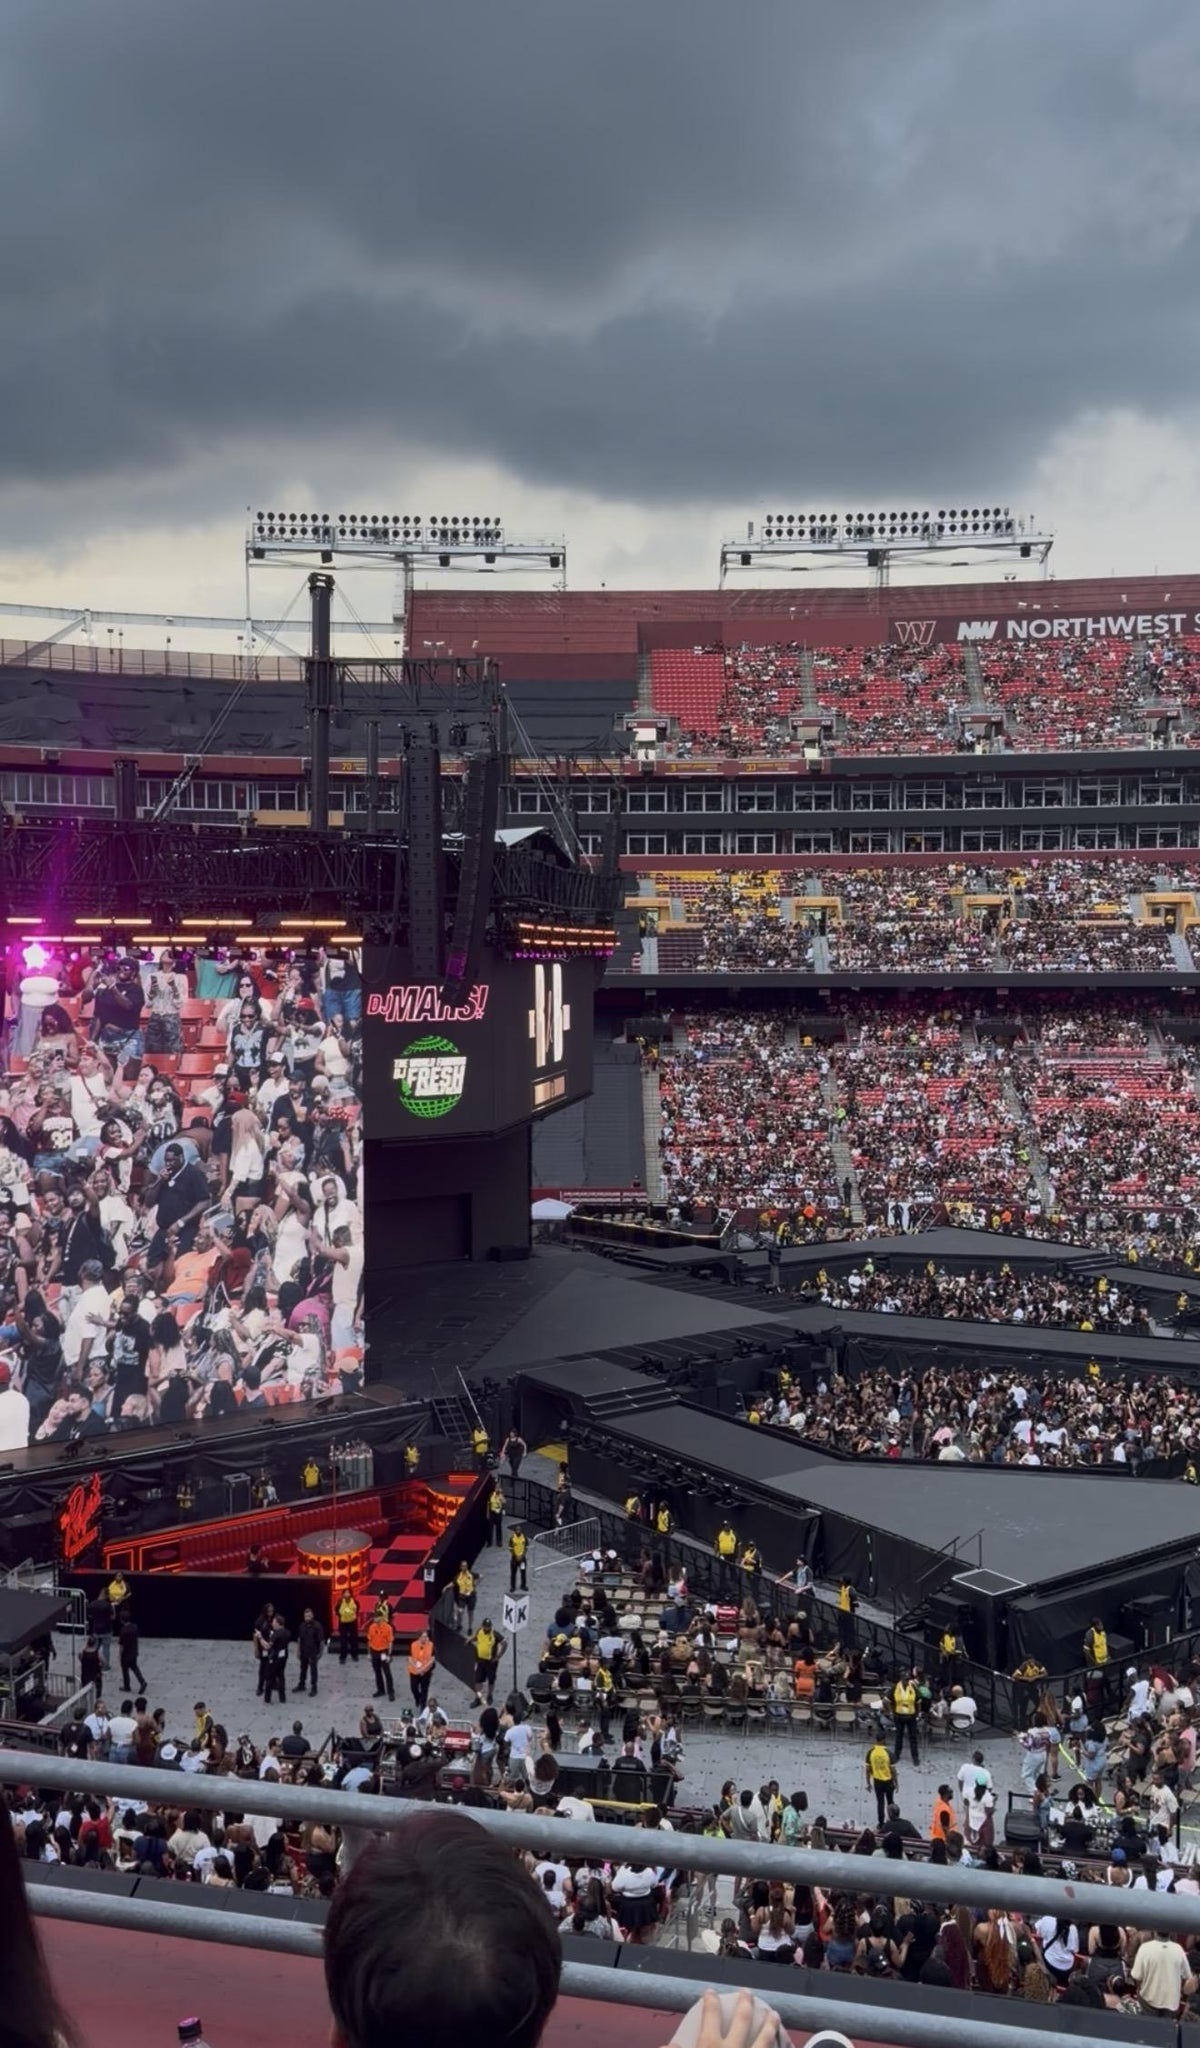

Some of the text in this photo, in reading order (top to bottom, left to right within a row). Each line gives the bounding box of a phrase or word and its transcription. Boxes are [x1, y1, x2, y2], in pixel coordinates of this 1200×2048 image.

[1007, 613, 1187, 638] NORTHWEST
[407, 1065, 465, 1091] FRESH
[505, 1605, 513, 1623] K
[517, 1605, 527, 1623] K
